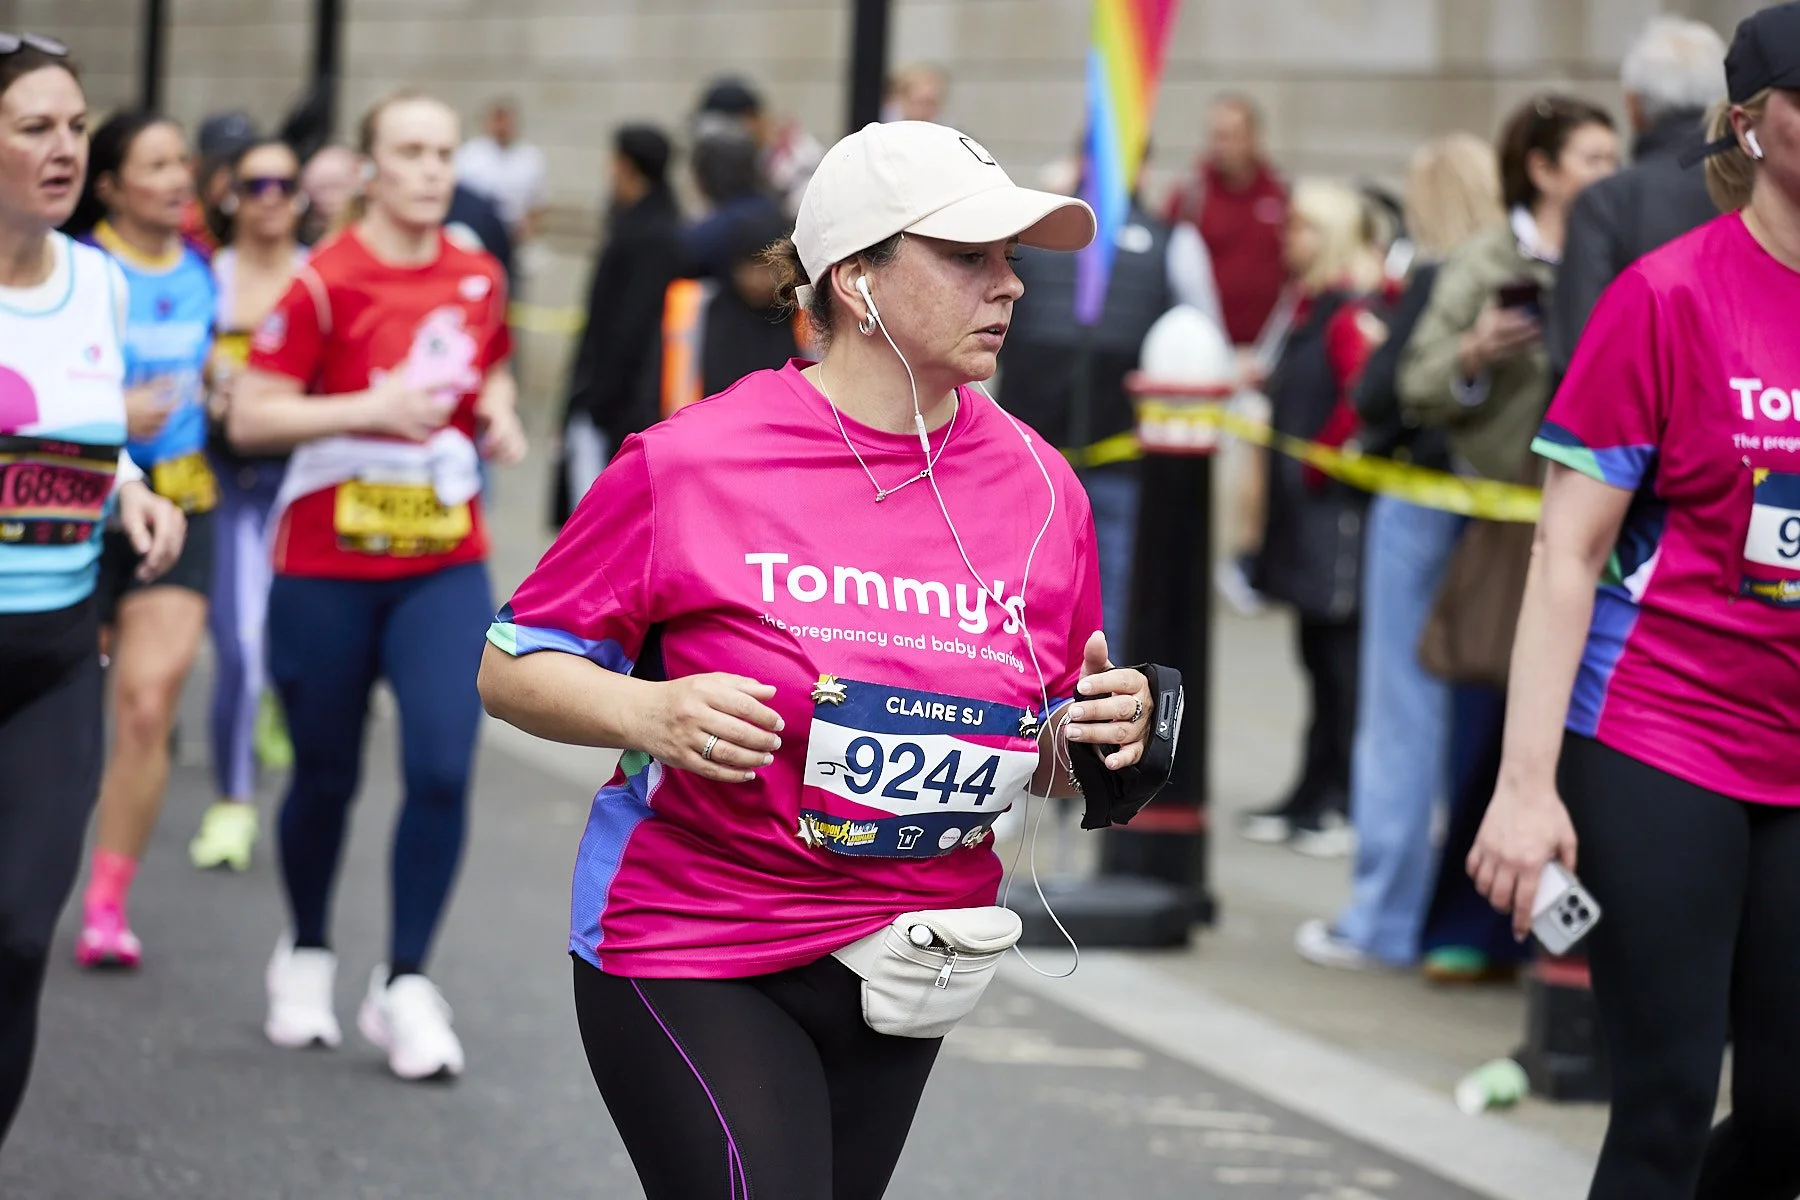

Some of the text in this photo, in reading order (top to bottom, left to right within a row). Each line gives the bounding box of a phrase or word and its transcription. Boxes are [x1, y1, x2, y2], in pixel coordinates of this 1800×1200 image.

[1728, 376, 1800, 422] To
[1731, 432, 1761, 450] The
[744, 552, 1026, 635] Tommy's
[789, 624, 888, 647] pregnancy
[893, 632, 926, 650] and
[931, 635, 977, 659] baby
[980, 645, 1025, 674] charity
[885, 696, 984, 726] CLAIRE SJ
[843, 735, 1001, 806] 9244
[815, 821, 841, 836] LONDON
[848, 832, 876, 843] LANDMARKS
